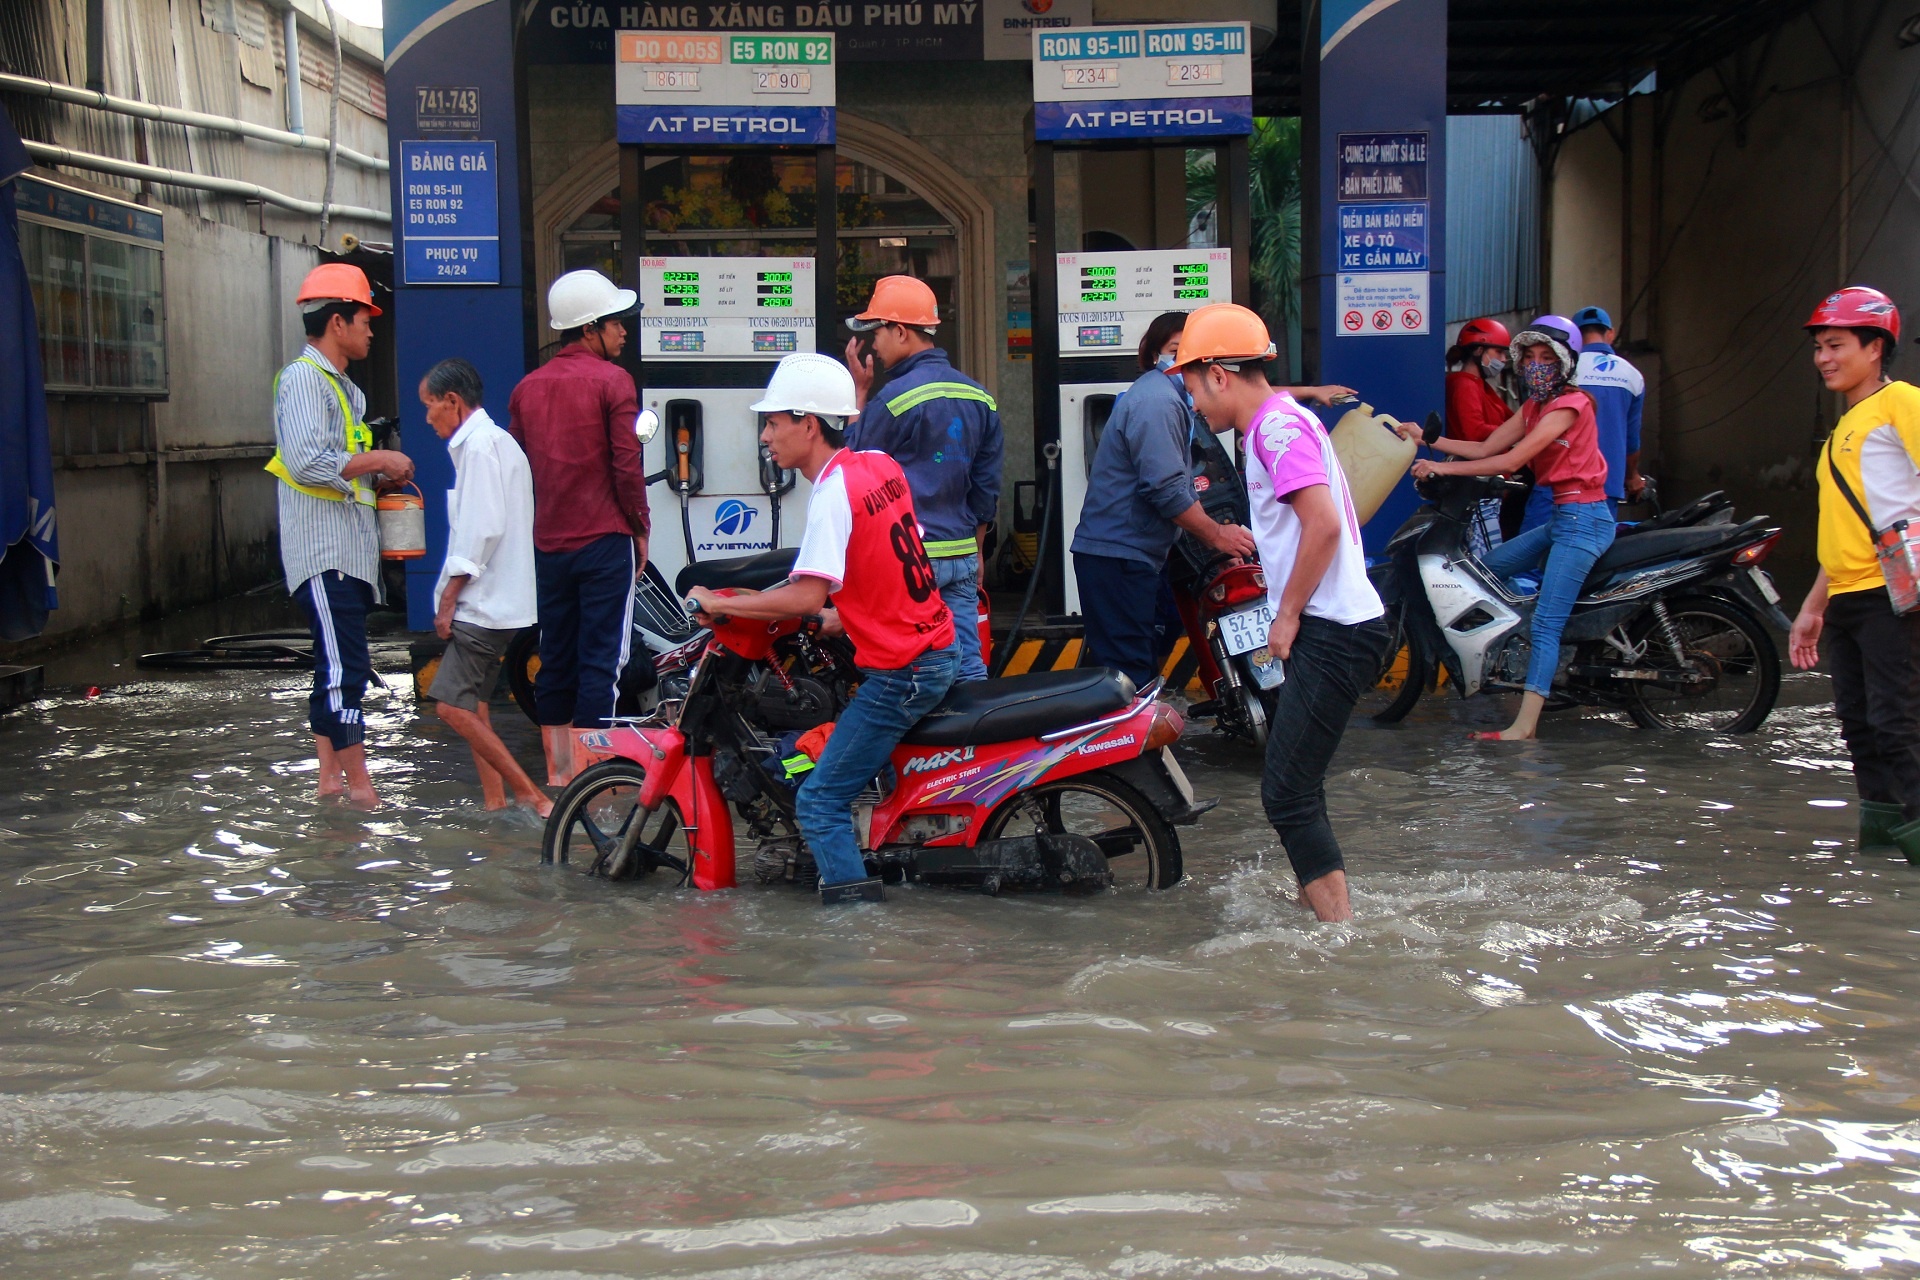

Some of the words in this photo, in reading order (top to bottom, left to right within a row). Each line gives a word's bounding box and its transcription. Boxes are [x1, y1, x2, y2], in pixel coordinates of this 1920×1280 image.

[550, 0, 611, 28] CỬA
[620, 1, 699, 28] HÀNG
[709, 2, 784, 27] XĂNG
[796, 0, 852, 27] DẦU
[864, 0, 923, 26] PHÚ
[933, 0, 977, 25] MỸ
[733, 41, 755, 59] E5
[762, 42, 799, 60] RON
[806, 42, 828, 60] 92
[1043, 38, 1081, 57] RON
[1087, 36, 1137, 55] 95-III
[1149, 34, 1186, 53] RON
[1192, 32, 1242, 51] 95-III
[635, 41, 660, 58] DO
[667, 41, 718, 62] 0,05S
[418, 90, 477, 114] 741-743
[693, 117, 806, 133] PETROL
[1111, 109, 1222, 127] PETROL
[411, 151, 455, 171] BẢNG
[460, 152, 487, 171] GIÁ
[1345, 145, 1364, 163] CUNG
[409, 185, 431, 195] RON
[434, 185, 462, 195] 95-III
[1345, 172, 1360, 195] BÁN
[410, 199, 423, 210] E5
[426, 199, 447, 209] RON
[450, 199, 463, 209] 92
[410, 213, 424, 224] DO
[427, 213, 457, 226] 0,05S
[1365, 211, 1382, 228] BÁN
[1344, 235, 1360, 247] XE
[1365, 232, 1374, 247] Ô
[1378, 231, 1394, 247] TÔ
[426, 248, 458, 262] PHỤC
[462, 248, 478, 262] VỤ
[642, 259, 651, 267] DO
[1344, 253, 1360, 265] XE
[1395, 249, 1421, 265] MÁY
[437, 265, 467, 276] 24/24
[642, 318, 662, 327] TCCS
[749, 318, 770, 328] TCCS
[1059, 313, 1079, 323] TCCS
[716, 542, 773, 550] VIETNAM
[890, 511, 937, 603] 89
[1228, 607, 1272, 633] 52-Z8
[1077, 734, 1135, 756] Kawasaki
[926, 774, 958, 790] ELECTRIC
[958, 766, 982, 780] START
